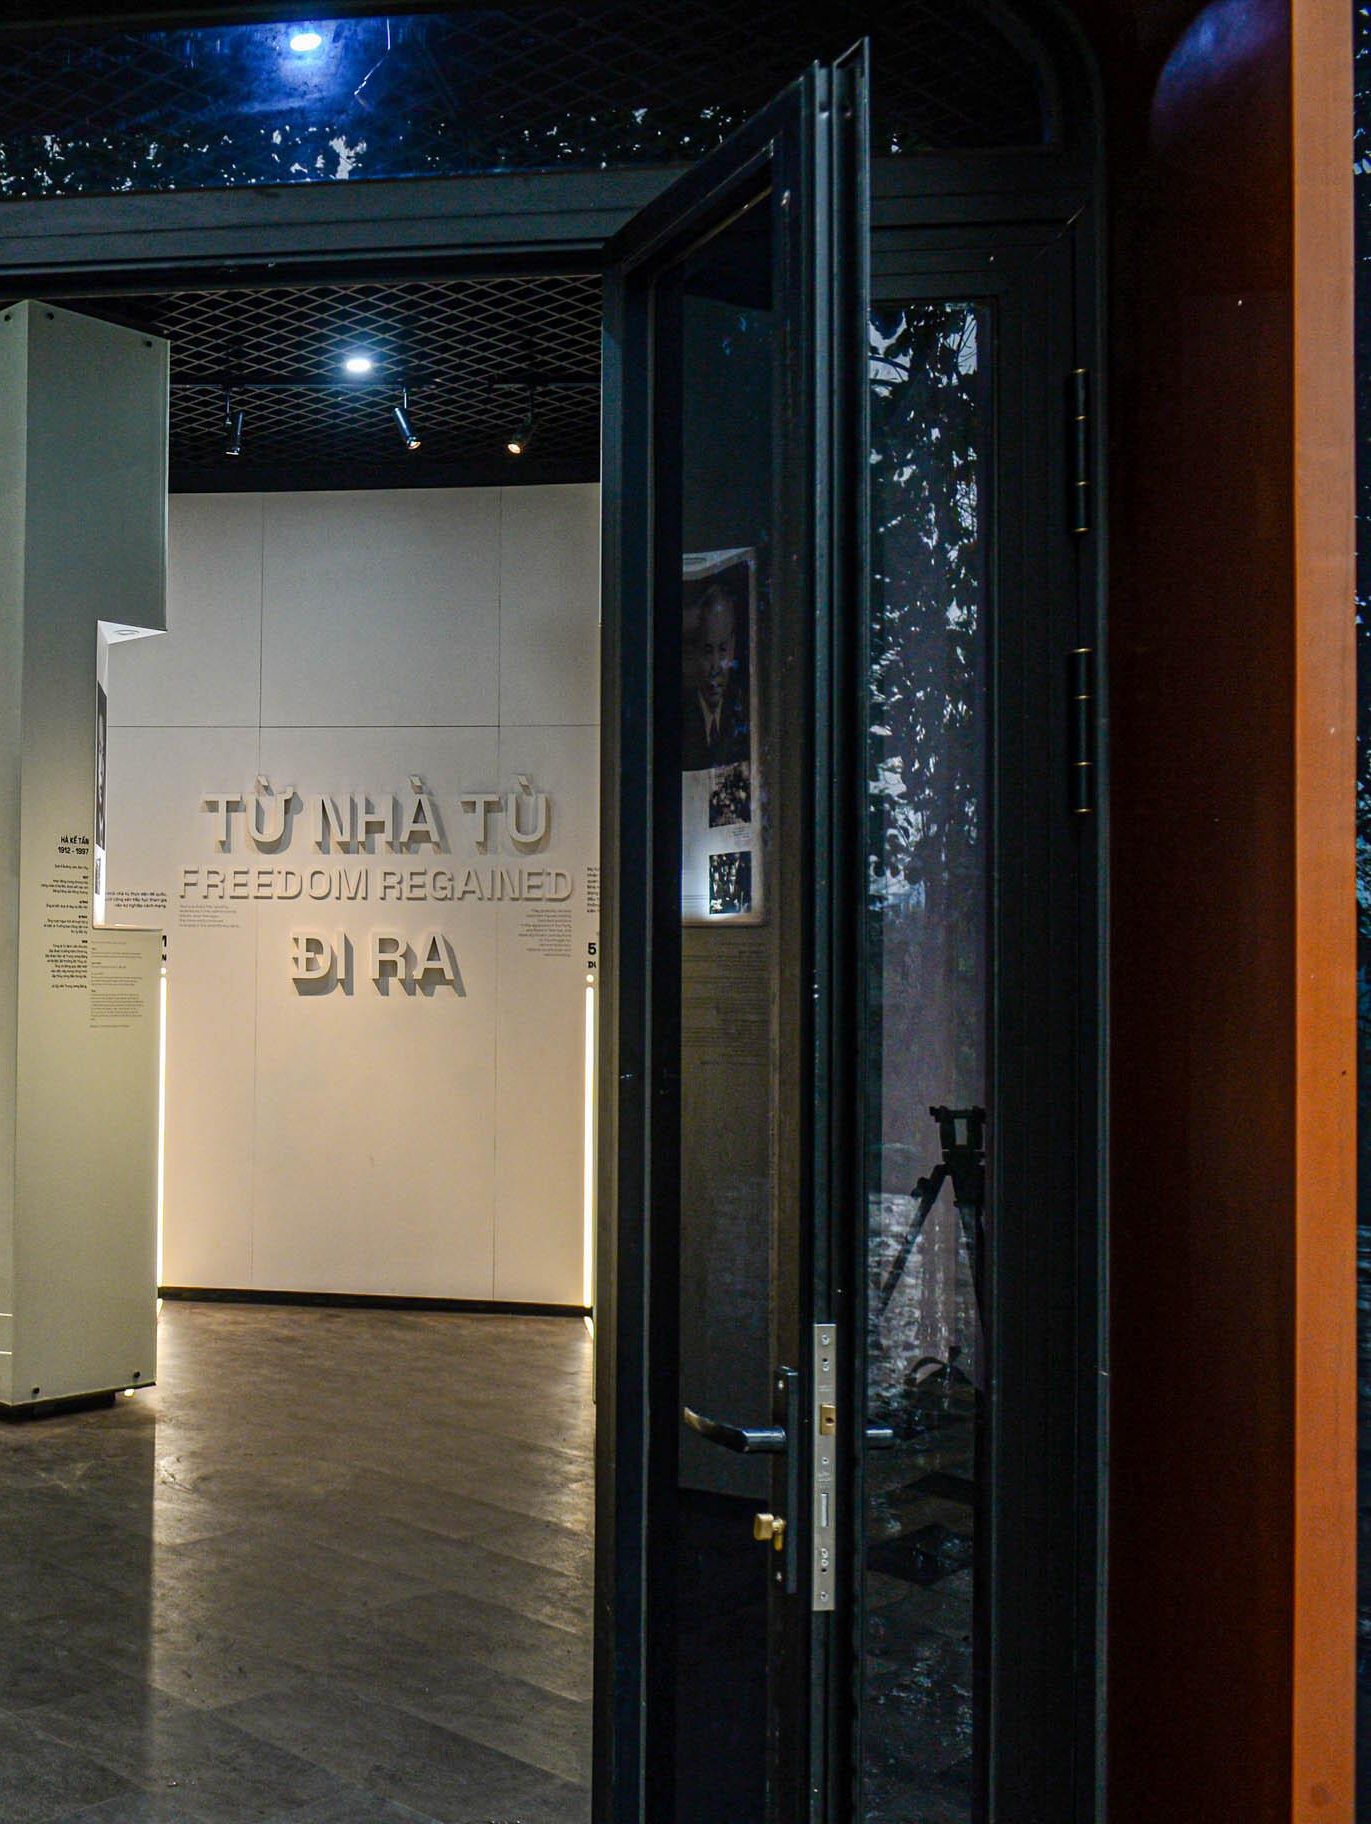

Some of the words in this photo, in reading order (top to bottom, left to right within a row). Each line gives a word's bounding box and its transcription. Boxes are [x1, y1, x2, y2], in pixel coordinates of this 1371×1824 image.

[201, 774, 298, 848] TỪ
[312, 774, 446, 850] NHÀ
[459, 774, 550, 848] TÙ
[179, 865, 370, 901] FREEDOM
[379, 866, 575, 903] REGAINED
[290, 930, 350, 986] ĐI
[368, 930, 458, 986] RA
